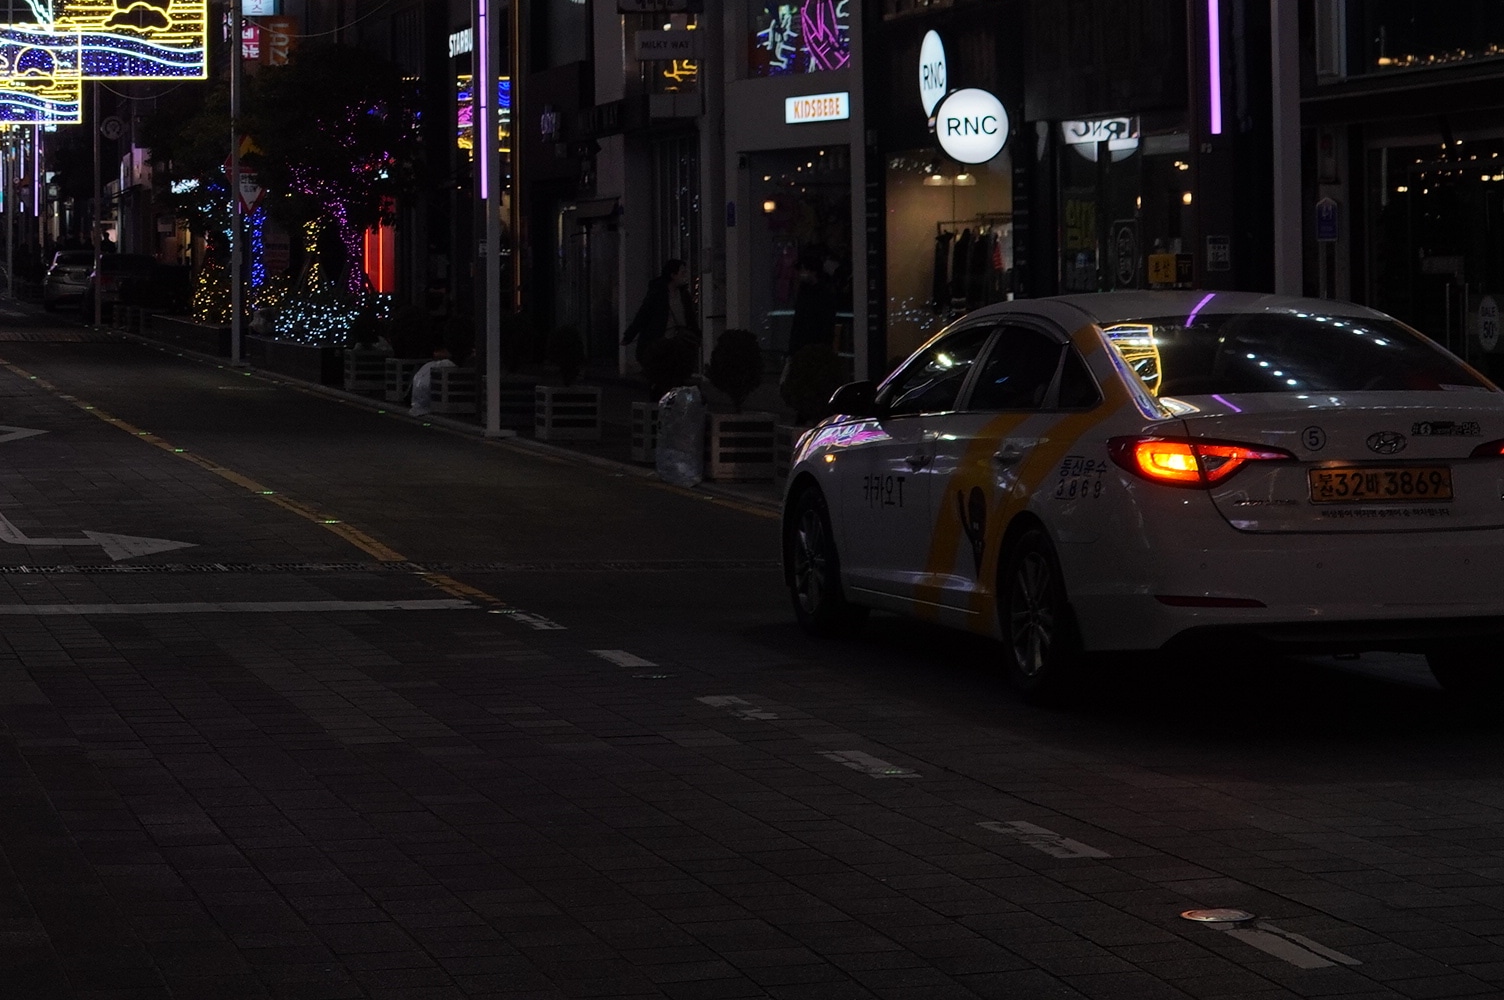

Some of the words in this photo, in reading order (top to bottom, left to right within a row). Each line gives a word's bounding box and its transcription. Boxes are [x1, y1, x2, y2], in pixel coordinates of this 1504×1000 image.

[922, 61, 945, 89] RNC
[793, 97, 840, 119] KIDSBEBE
[947, 115, 999, 137] RNC
[1308, 430, 1319, 446] 5
[864, 473, 905, 508] 카카오T
[1056, 478, 1103, 499] 3869
[1318, 473, 1334, 497] 부산
[1335, 472, 1380, 496] 32바
[1384, 470, 1443, 496] 3869
